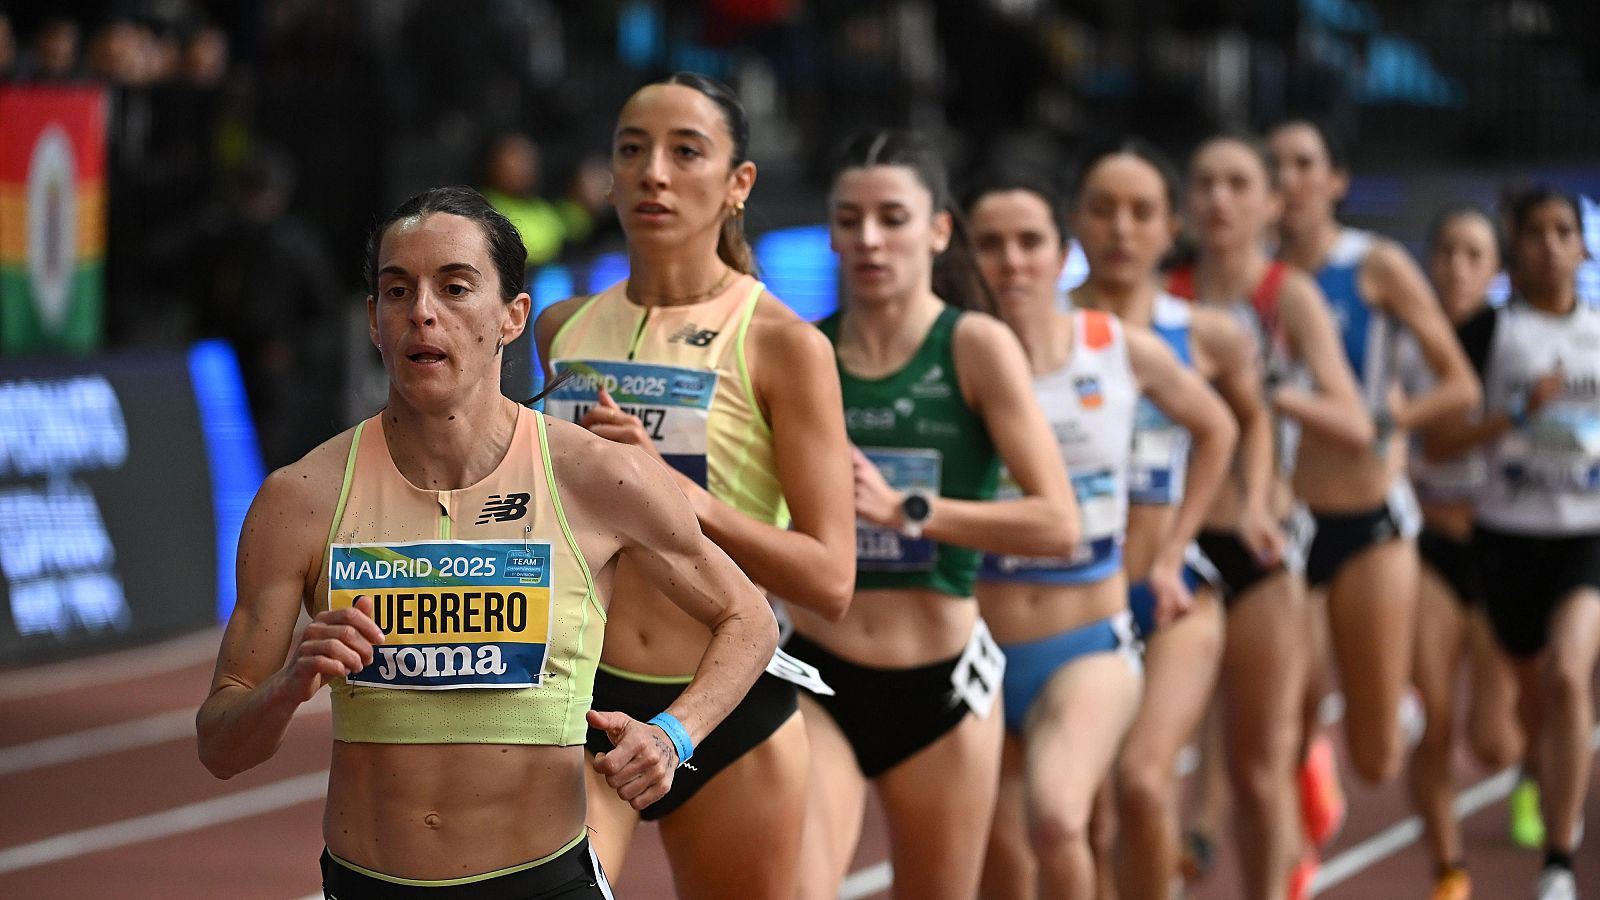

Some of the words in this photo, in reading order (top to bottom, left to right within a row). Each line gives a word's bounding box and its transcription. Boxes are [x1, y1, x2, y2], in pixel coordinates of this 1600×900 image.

[622, 375, 667, 396] 2025
[335, 557, 433, 580] MADRID
[438, 557, 497, 578] 2025
[353, 592, 527, 635] UERRERO
